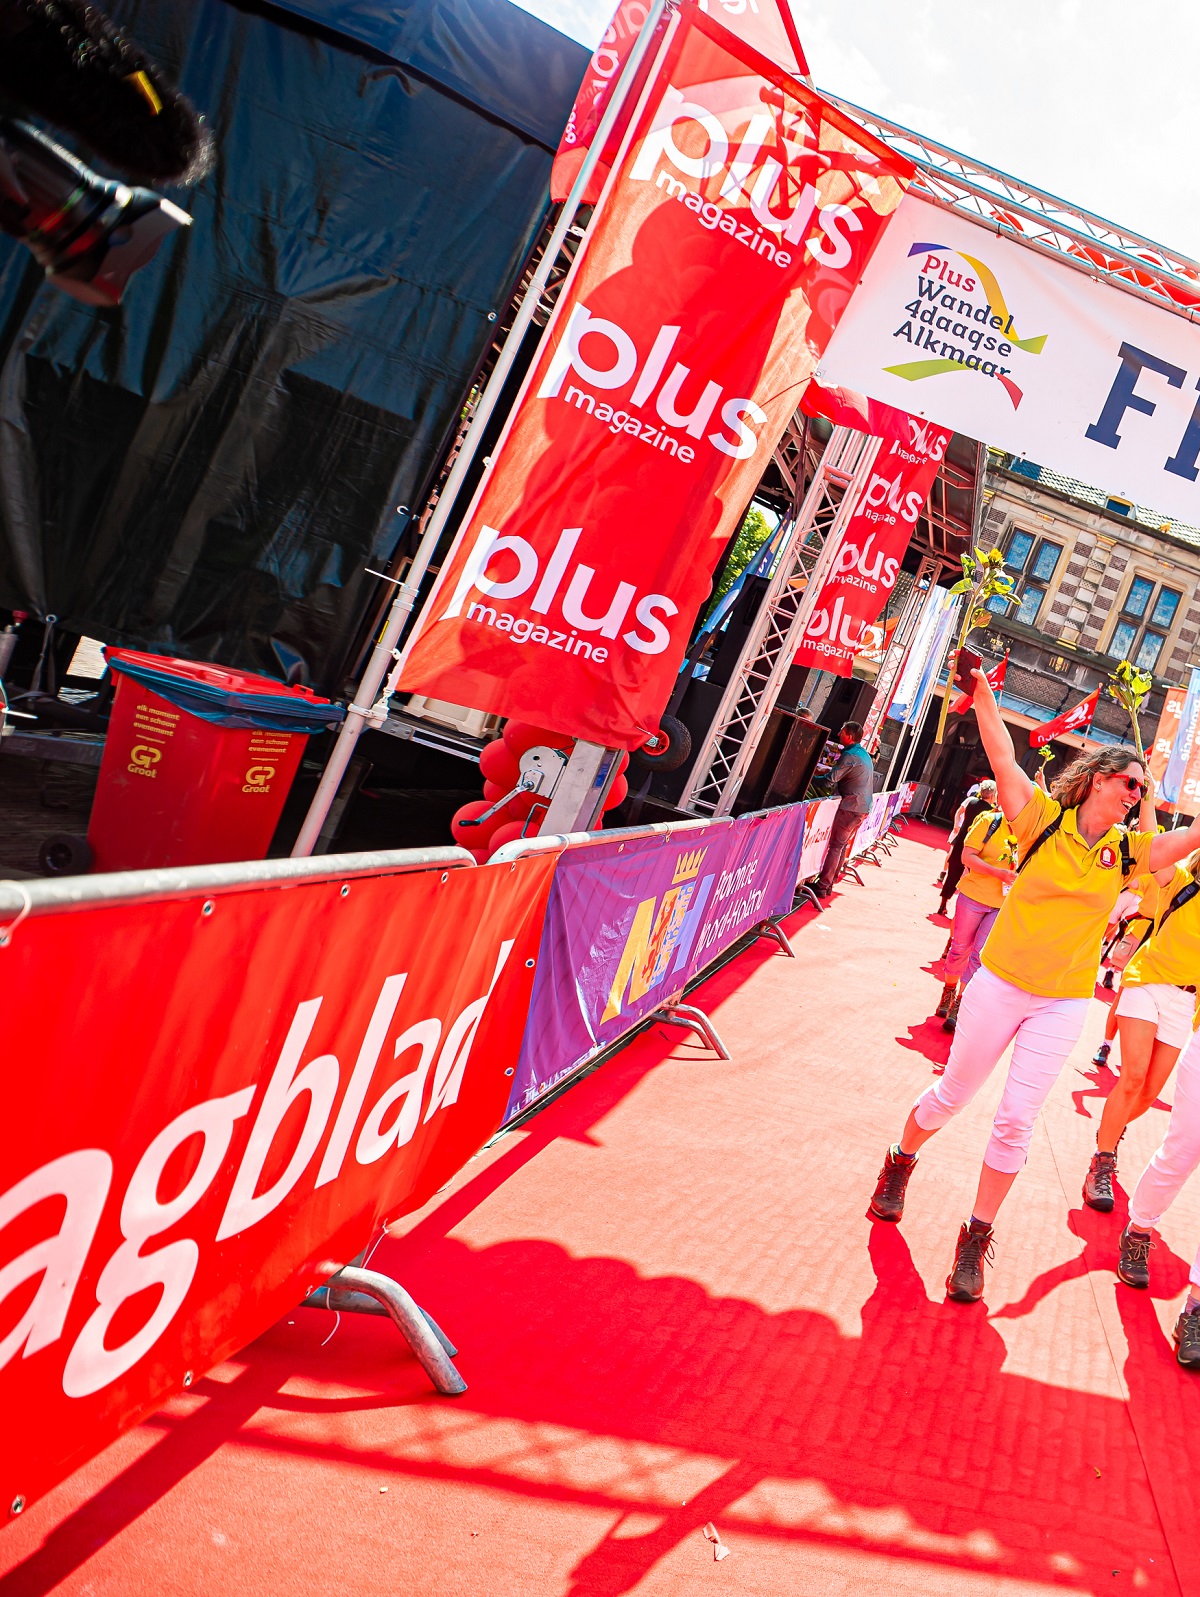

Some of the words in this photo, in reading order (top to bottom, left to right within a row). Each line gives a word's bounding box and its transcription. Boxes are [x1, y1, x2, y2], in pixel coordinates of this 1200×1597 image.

[631, 84, 865, 270] plus
[656, 170, 792, 269] magazine
[921, 254, 976, 292] Plus
[917, 275, 1015, 334] Wandel
[536, 302, 768, 461] plus
[893, 321, 1012, 381] Alkmaar
[564, 384, 696, 464] magazine
[439, 525, 679, 656] plus
[466, 600, 609, 664] magazine
[806, 596, 870, 651] plu
[127, 763, 158, 779] Groot
[241, 784, 270, 793] Groot
